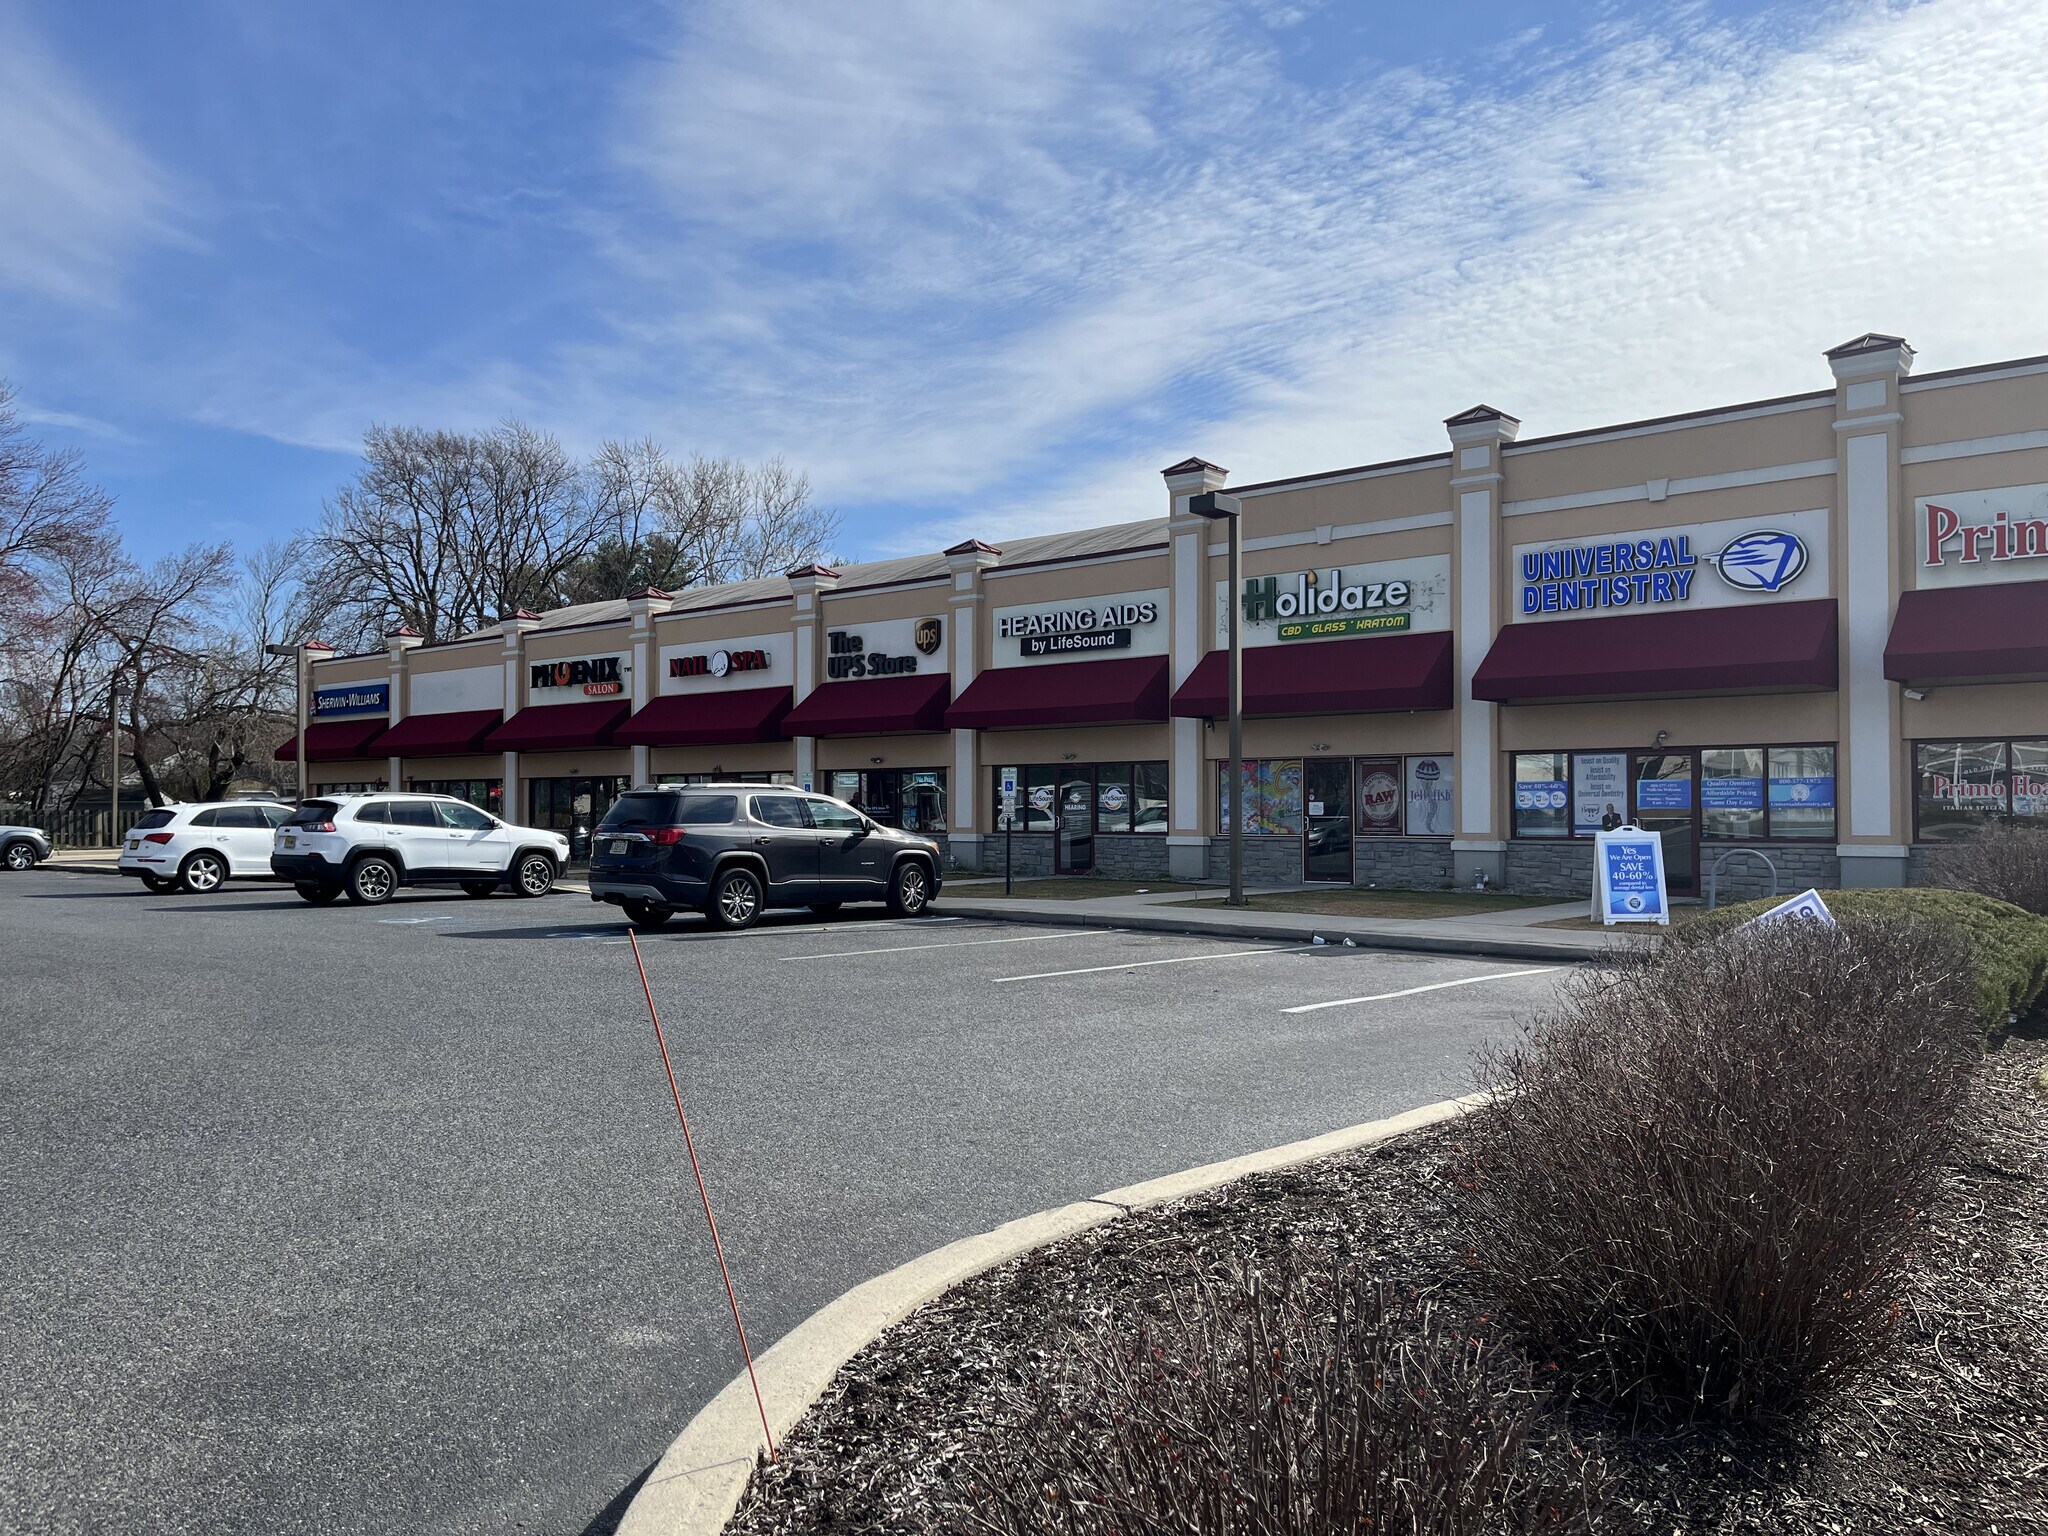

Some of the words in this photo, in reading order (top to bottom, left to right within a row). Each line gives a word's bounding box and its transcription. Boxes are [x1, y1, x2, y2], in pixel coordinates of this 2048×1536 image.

[1521, 534, 1696, 582] UNIVERSAL
[1242, 569, 1410, 621] Holidaze
[1522, 568, 1695, 614] DENTISTRY
[998, 608, 1096, 637] HEARING
[1100, 602, 1157, 627] AIDS
[1281, 626, 1302, 636] CBD
[1311, 621, 1346, 633] GLASS
[1356, 616, 1404, 629] KRATOM
[828, 631, 863, 654] The
[916, 629, 936, 649] ups
[1031, 639, 1046, 653] by
[1050, 632, 1115, 650] LifeSound
[531, 657, 621, 688] PHOENIX
[669, 655, 709, 677] NAIL
[731, 650, 767, 671] SPA
[828, 654, 866, 678] UPS
[867, 653, 917, 676] Store
[588, 683, 614, 694] SALON
[1933, 774, 2006, 798] Primo
[1364, 789, 1396, 806] RAW
[1621, 845, 1637, 855] Yes
[1633, 854, 1651, 862] Open
[1612, 871, 1653, 880] 40-60%
[1620, 862, 1644, 872] SAVE
